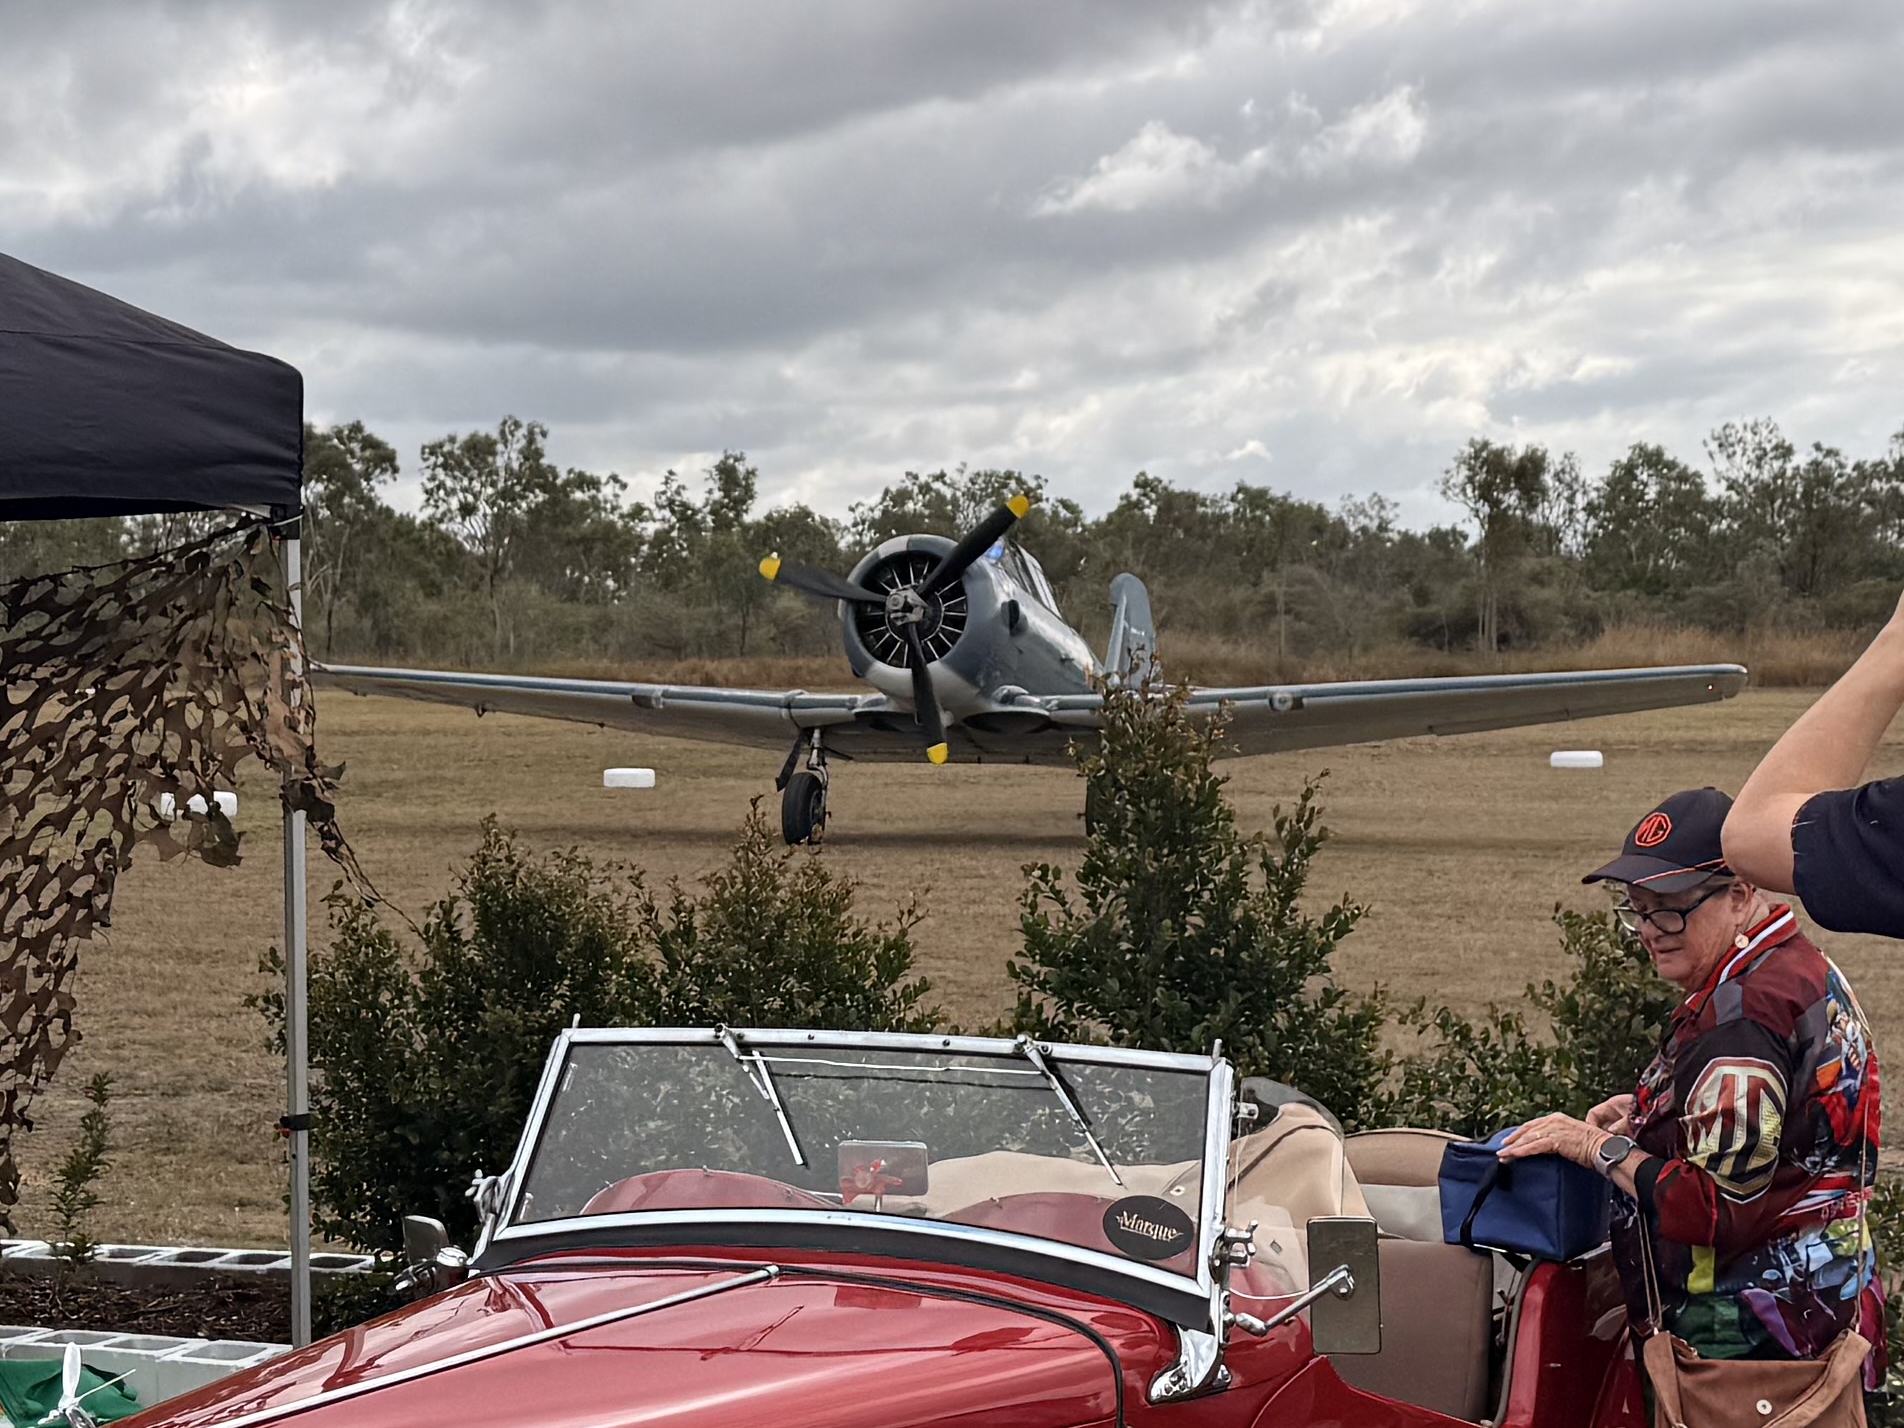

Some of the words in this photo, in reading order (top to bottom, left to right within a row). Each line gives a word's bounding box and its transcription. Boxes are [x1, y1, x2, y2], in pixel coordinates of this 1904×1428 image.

[1637, 814, 1668, 844] MG
[1686, 1068, 1786, 1186] MG
[1115, 1210, 1184, 1242] Marque
